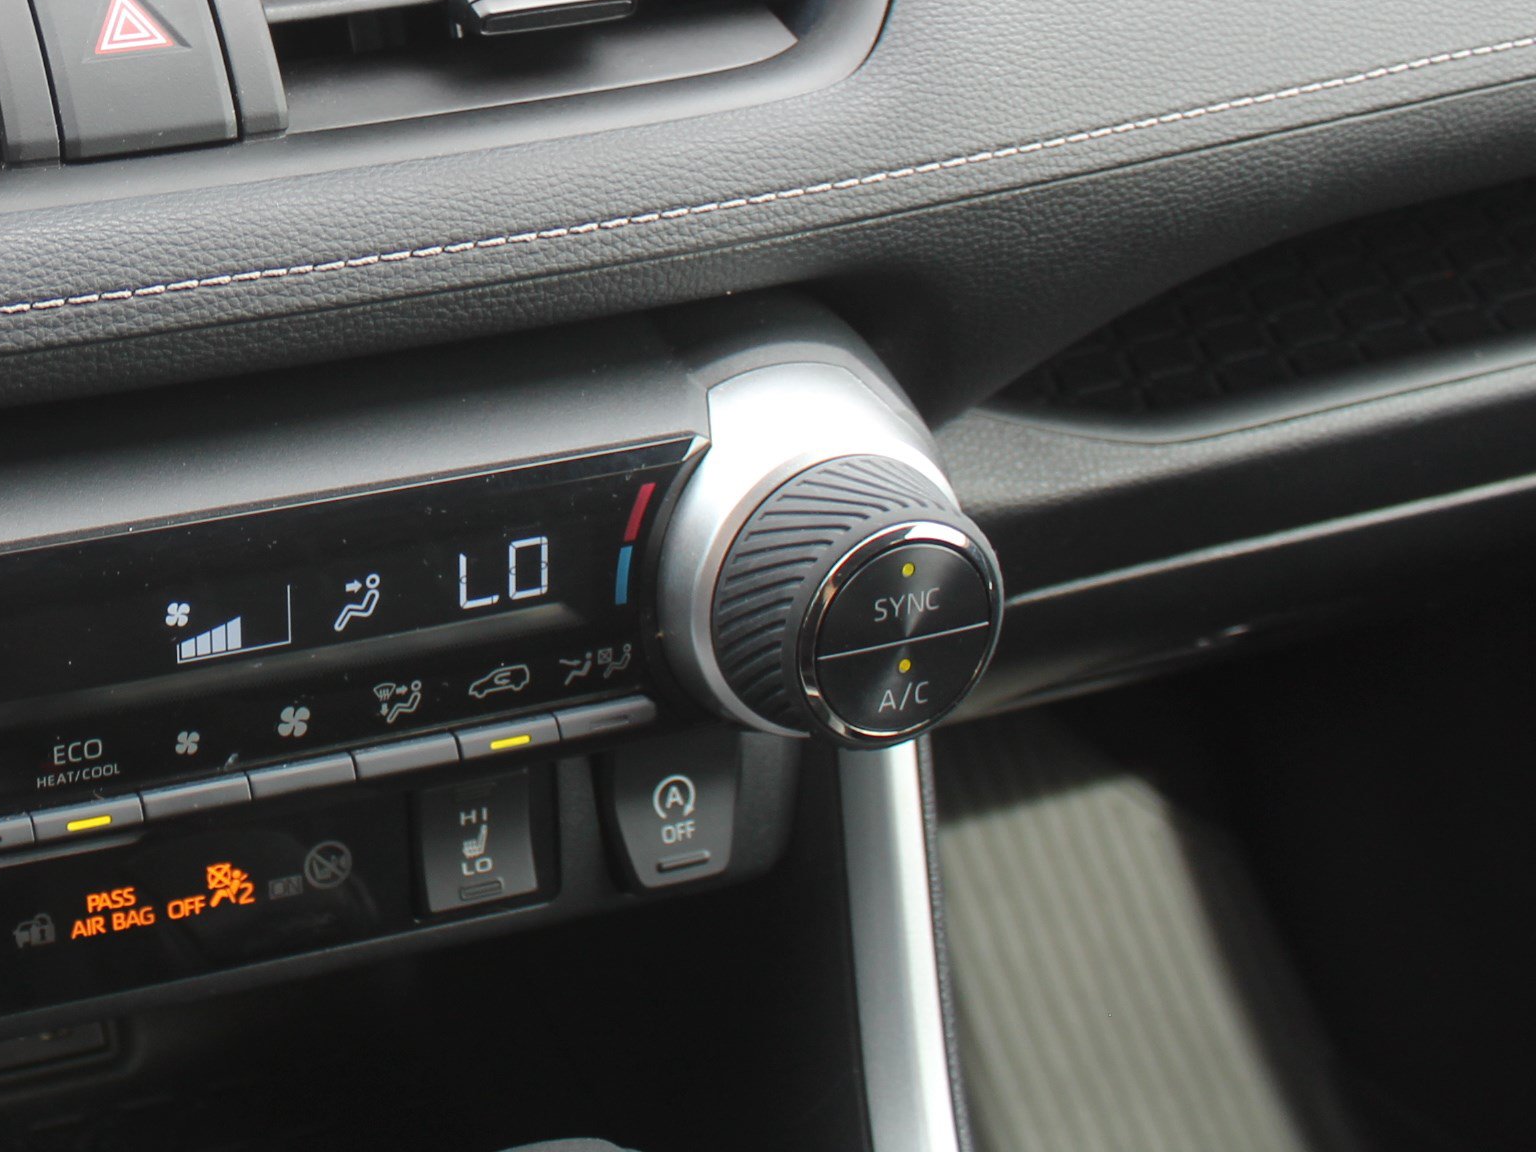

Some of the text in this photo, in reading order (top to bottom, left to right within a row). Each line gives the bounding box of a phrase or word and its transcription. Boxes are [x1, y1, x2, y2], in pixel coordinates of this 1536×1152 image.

[459, 536, 549, 609] LO
[874, 587, 940, 623] SYNC
[878, 681, 929, 713] A/C
[53, 739, 102, 766] ECO
[36, 763, 121, 789] HEAT/COOL
[460, 807, 488, 825] HI
[662, 821, 696, 844] OFF
[462, 857, 492, 876] LO
[87, 888, 136, 913] PASS
[71, 917, 106, 939] AIR
[112, 906, 155, 931] BAG
[167, 895, 206, 920] OFF
